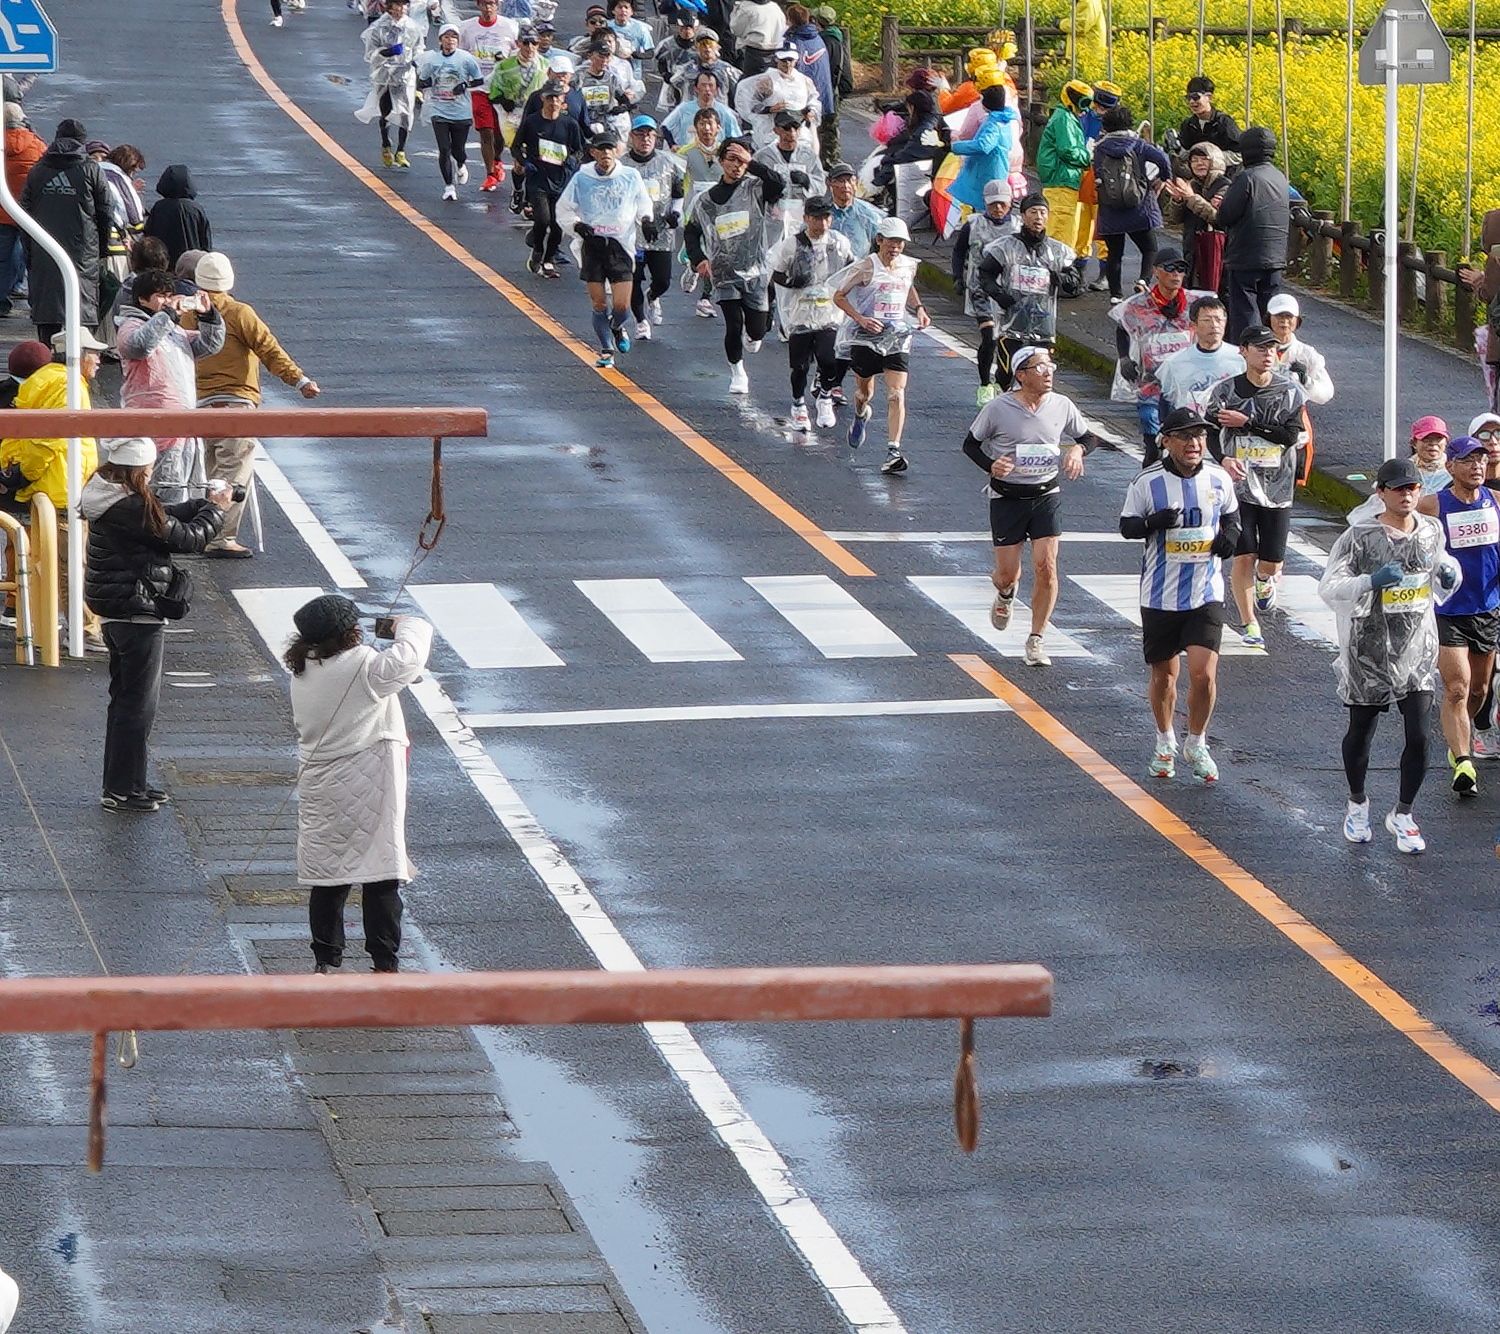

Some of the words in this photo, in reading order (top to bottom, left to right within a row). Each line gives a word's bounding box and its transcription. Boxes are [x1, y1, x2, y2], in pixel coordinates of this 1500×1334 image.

[42, 186, 77, 196] adidas
[1020, 457, 1053, 466] 30256
[1458, 522, 1489, 536] 5380
[1174, 540, 1204, 551] 3057
